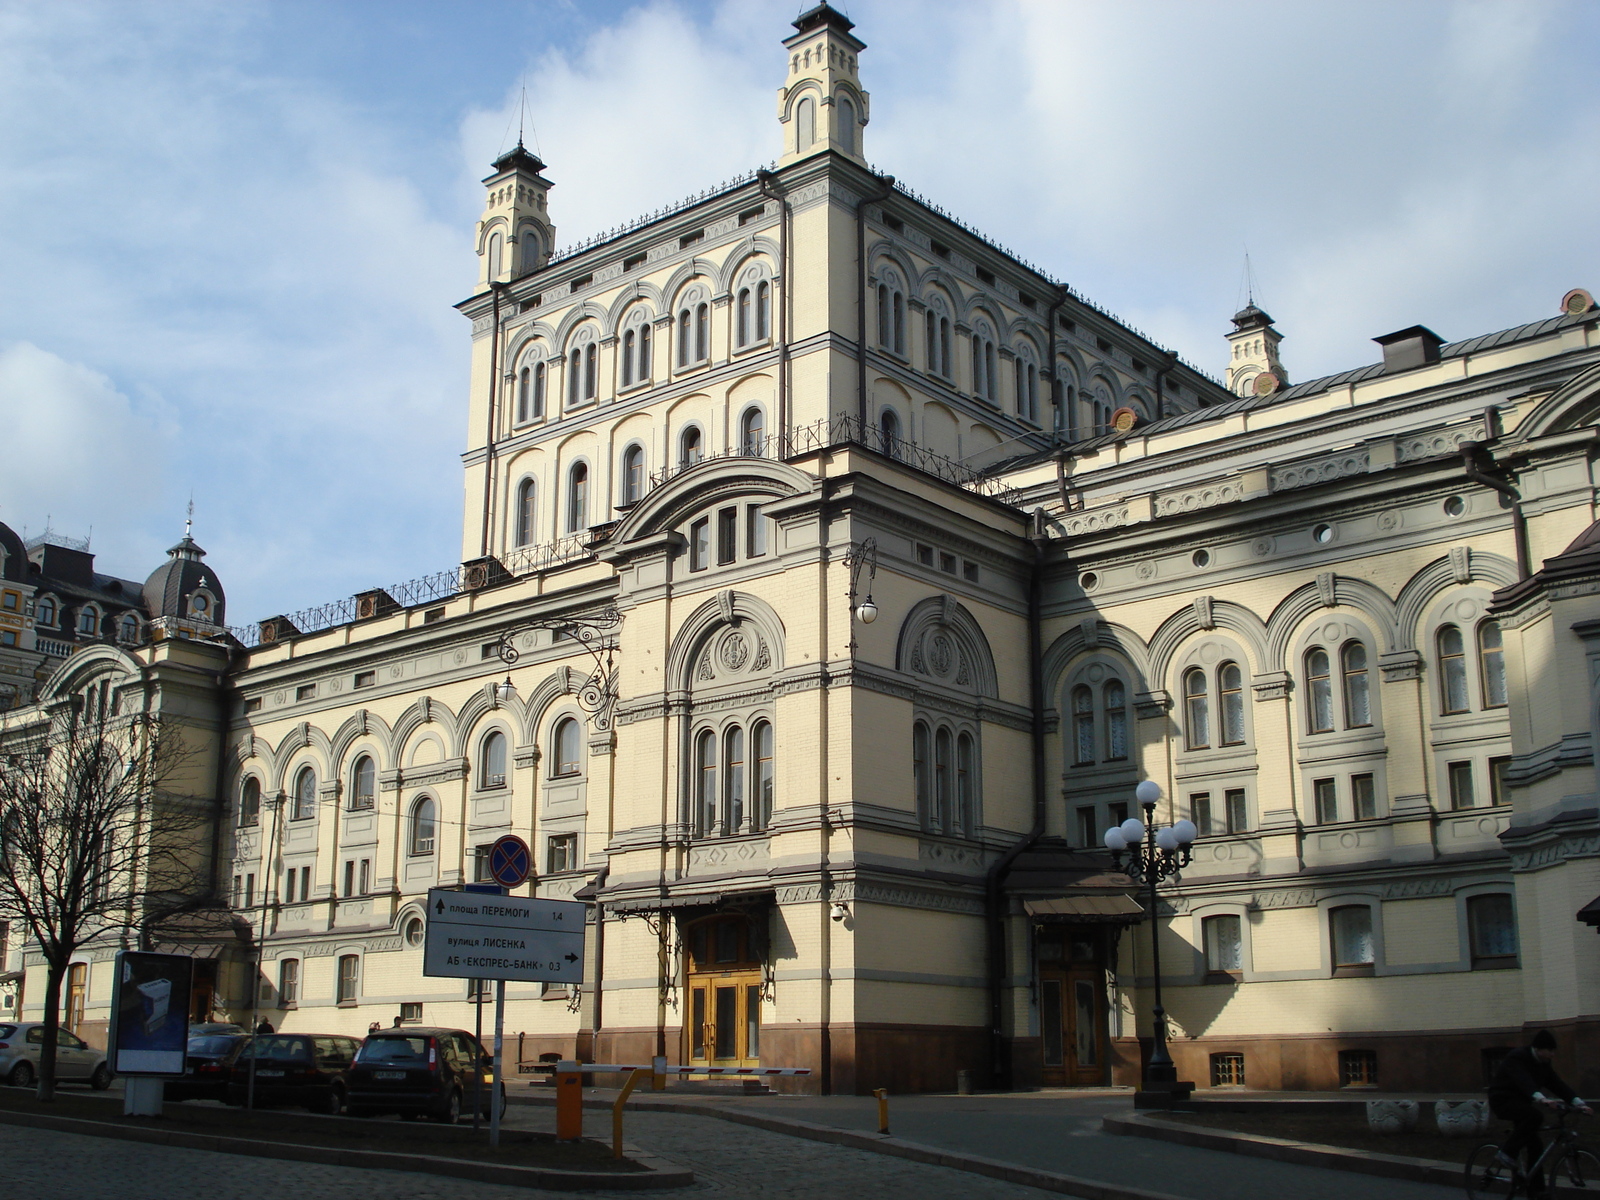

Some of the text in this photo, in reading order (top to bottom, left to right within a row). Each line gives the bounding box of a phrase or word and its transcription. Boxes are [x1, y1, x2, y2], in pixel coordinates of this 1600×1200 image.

[450, 905, 563, 921] площа ПЕРЕМОГИ 1,4
[448, 937, 526, 949] вулиця ЛИСЕНКА
[447, 956, 460, 966] АБ
[548, 961, 561, 971] 0,3
